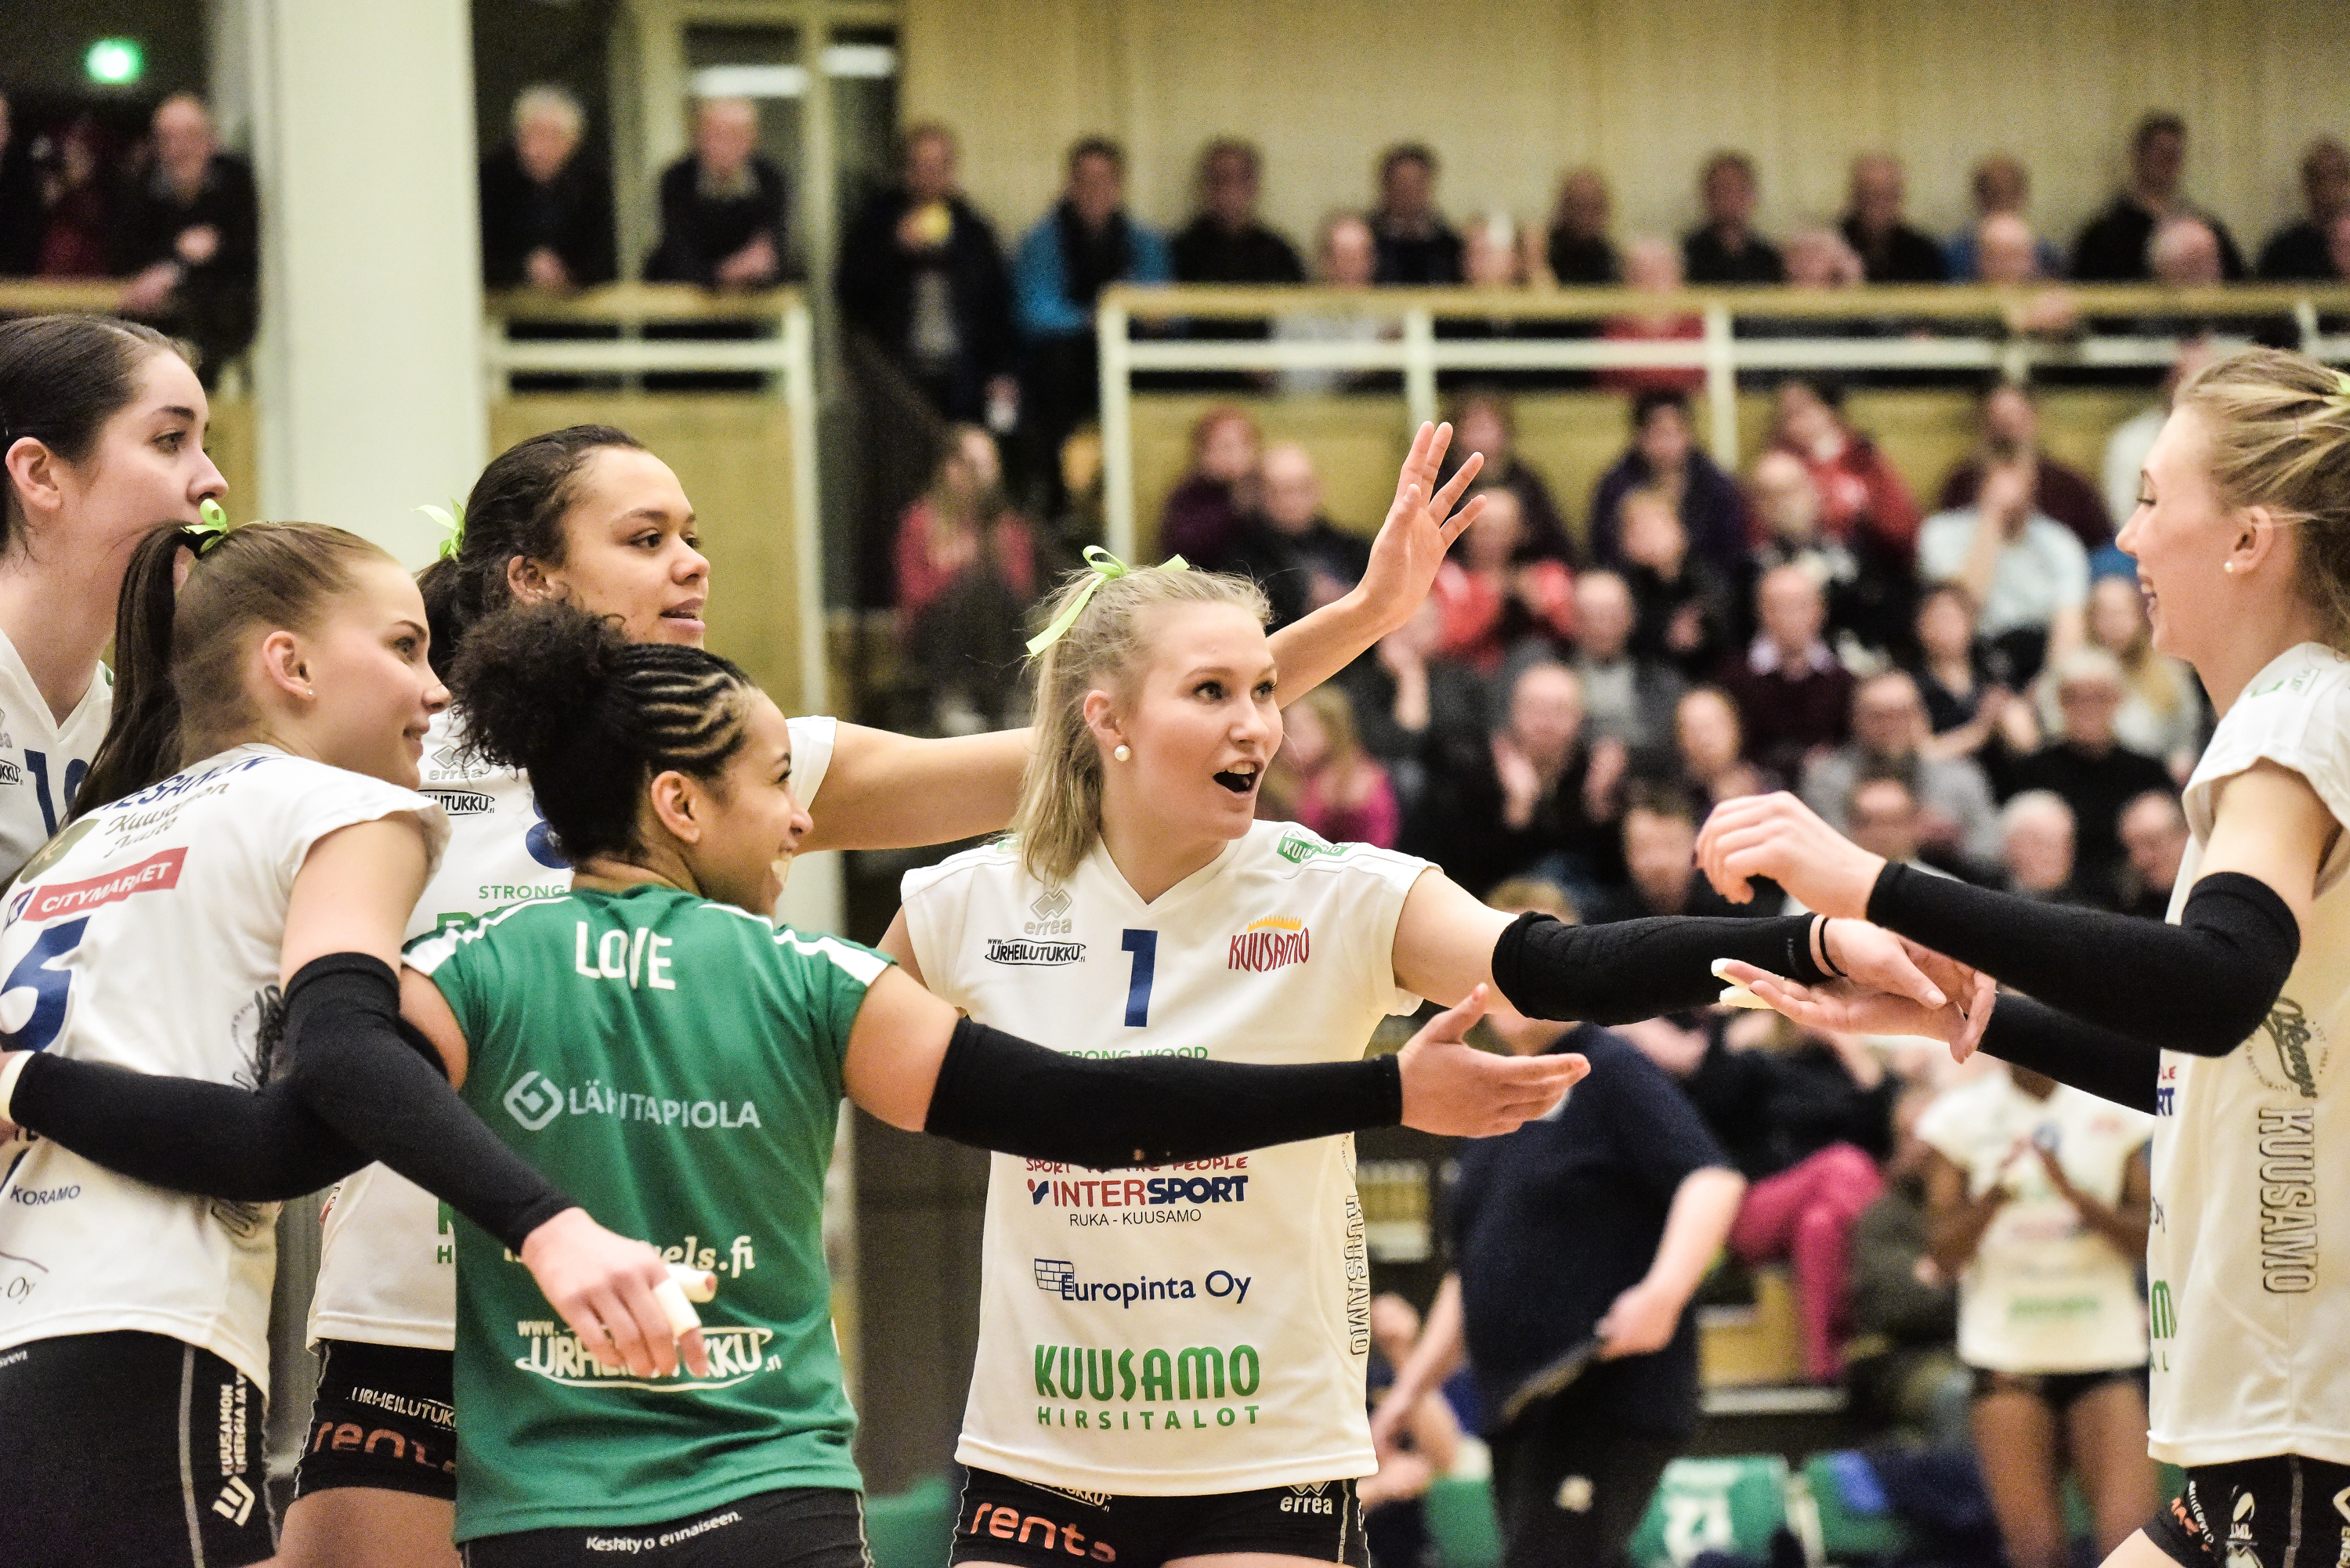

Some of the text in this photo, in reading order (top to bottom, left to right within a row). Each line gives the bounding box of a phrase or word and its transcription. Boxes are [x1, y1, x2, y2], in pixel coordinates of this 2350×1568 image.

[41, 862, 172, 912] CITYMARKET
[479, 884, 566, 899] STRONG
[1024, 918, 1072, 936] errea
[1228, 927, 1310, 973] KUUSAMO
[1122, 928, 1158, 1028] 1
[10, 1184, 81, 1205] KORAMO
[1053, 1175, 1249, 1208] INTERSPORT
[2259, 1107, 2319, 1294] KUUSAMO
[1069, 1213, 1109, 1227] RUKA
[1123, 1209, 1202, 1225] KUUSAMO
[1061, 1270, 1252, 1309] Europinta Oy
[1343, 1194, 1370, 1356] KUUSAMO
[1035, 1344, 1260, 1401] KUUSAMO
[1037, 1405, 1260, 1431] HIRSITALOT
[1280, 1496, 1332, 1515] errea
